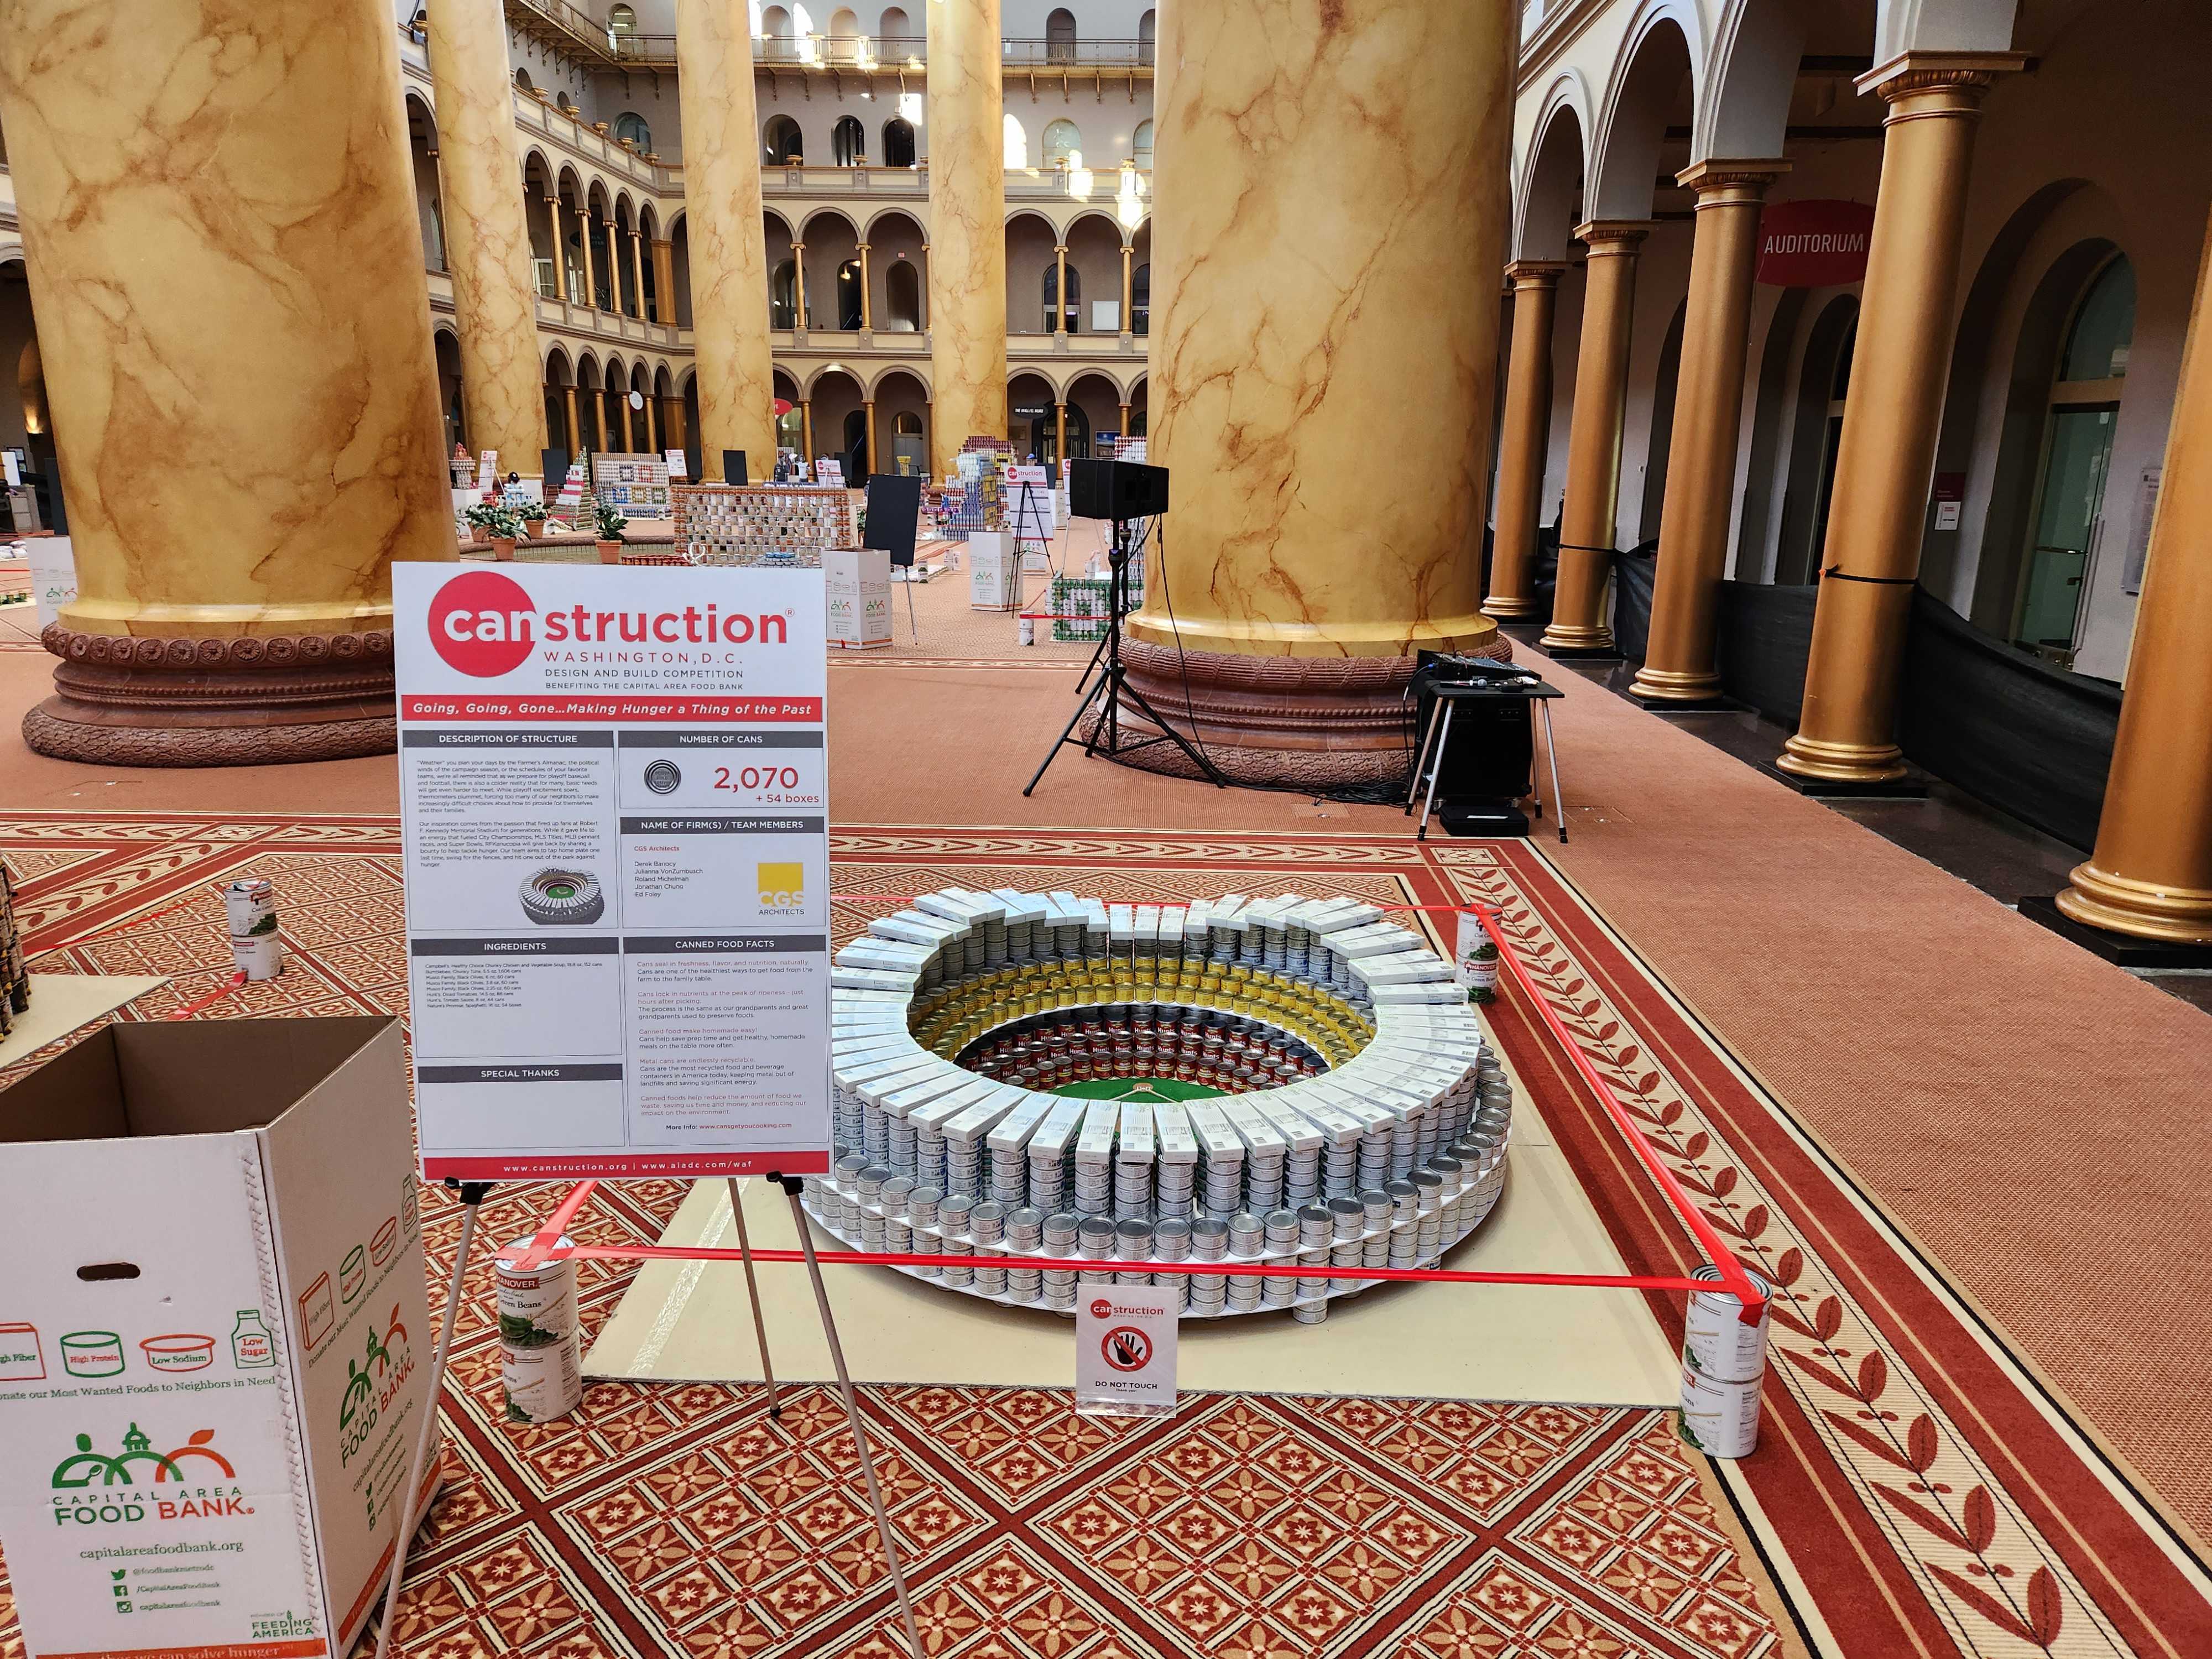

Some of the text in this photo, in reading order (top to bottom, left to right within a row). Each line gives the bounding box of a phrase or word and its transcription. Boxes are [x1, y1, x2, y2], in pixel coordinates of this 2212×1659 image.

[1764, 233, 1864, 254] AUDITORIUM
[413, 703, 458, 714] Going,
[466, 703, 511, 714] Going,
[622, 704, 672, 714] Hunger
[692, 704, 729, 716] Thing
[735, 705, 749, 713] of
[755, 705, 776, 713] the
[782, 705, 811, 714] Past
[714, 768, 798, 792] 2,070
[767, 794, 781, 802] 54
[786, 794, 818, 802] boxes
[758, 891, 805, 907] CGS
[243, 1337, 263, 1347] Low
[0, 1353, 36, 1364] gh Fiber
[70, 1353, 119, 1364] High Protein
[241, 1347, 268, 1358] Sugar
[152, 1354, 207, 1365] Low Sodium
[50, 1389, 77, 1397] Most
[81, 1385, 123, 1395] Wanted
[127, 1384, 159, 1394] Foods
[175, 1380, 231, 1391] Neighbors
[247, 1376, 275, 1385] Need
[341, 1345, 411, 1449] CAPITAL AREA
[342, 1408, 377, 1469] FOOD
[53, 1486, 242, 1505] CAPITAL AREA
[55, 1505, 144, 1526] FOOD
[80, 1541, 244, 1561] capitalareafoodbank.org
[252, 1619, 312, 1630] FEEDING
[252, 1627, 314, 1639] AMERICA
[189, 1647, 225, 1658] solve
